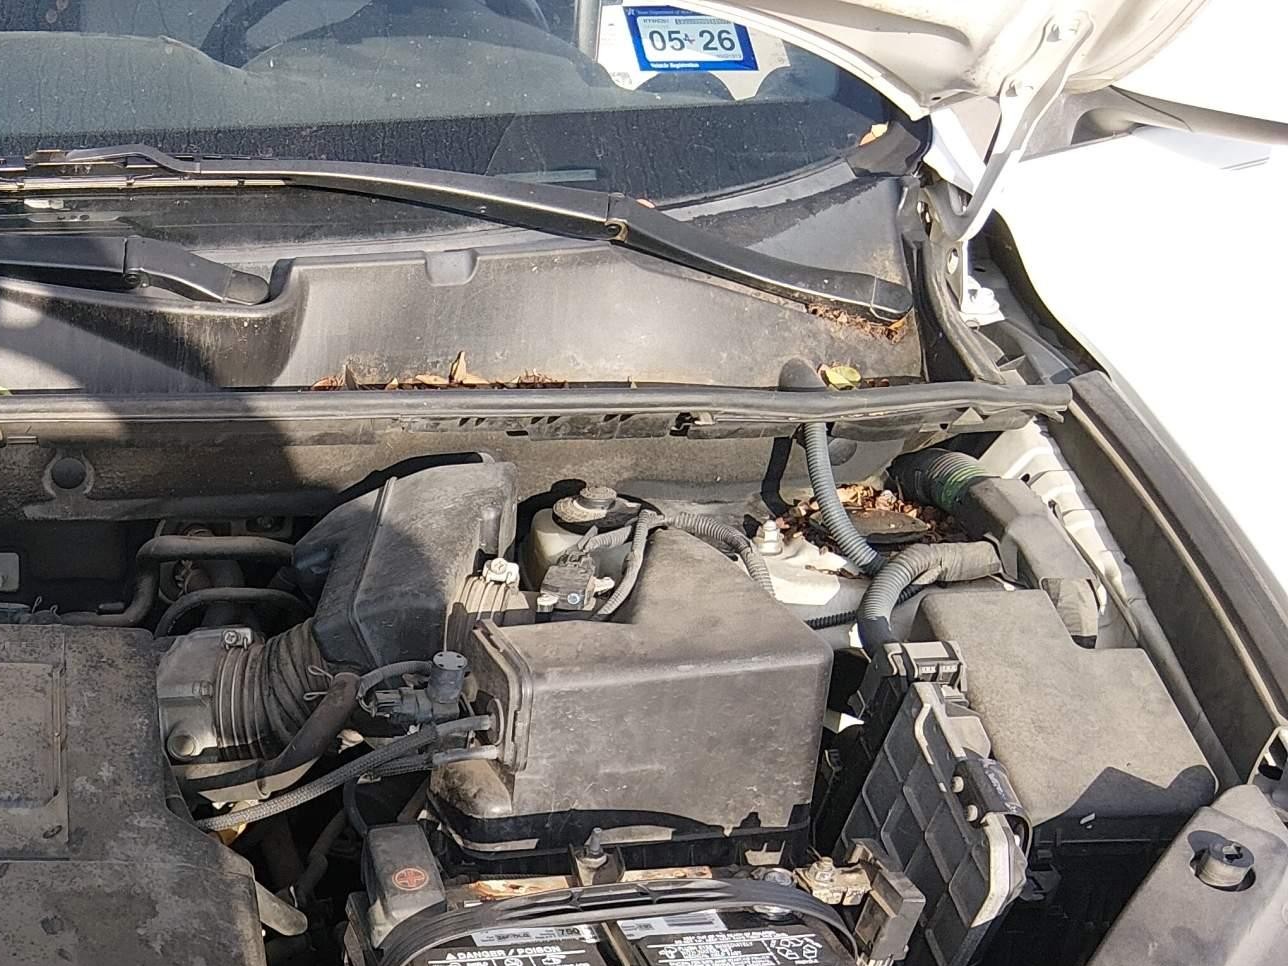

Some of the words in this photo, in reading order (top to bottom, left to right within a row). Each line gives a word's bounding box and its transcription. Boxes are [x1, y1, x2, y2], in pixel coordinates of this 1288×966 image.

[648, 30, 685, 52] 05
[698, 29, 736, 52] 26
[457, 950, 507, 961] DANGER
[517, 946, 562, 956] POISON
